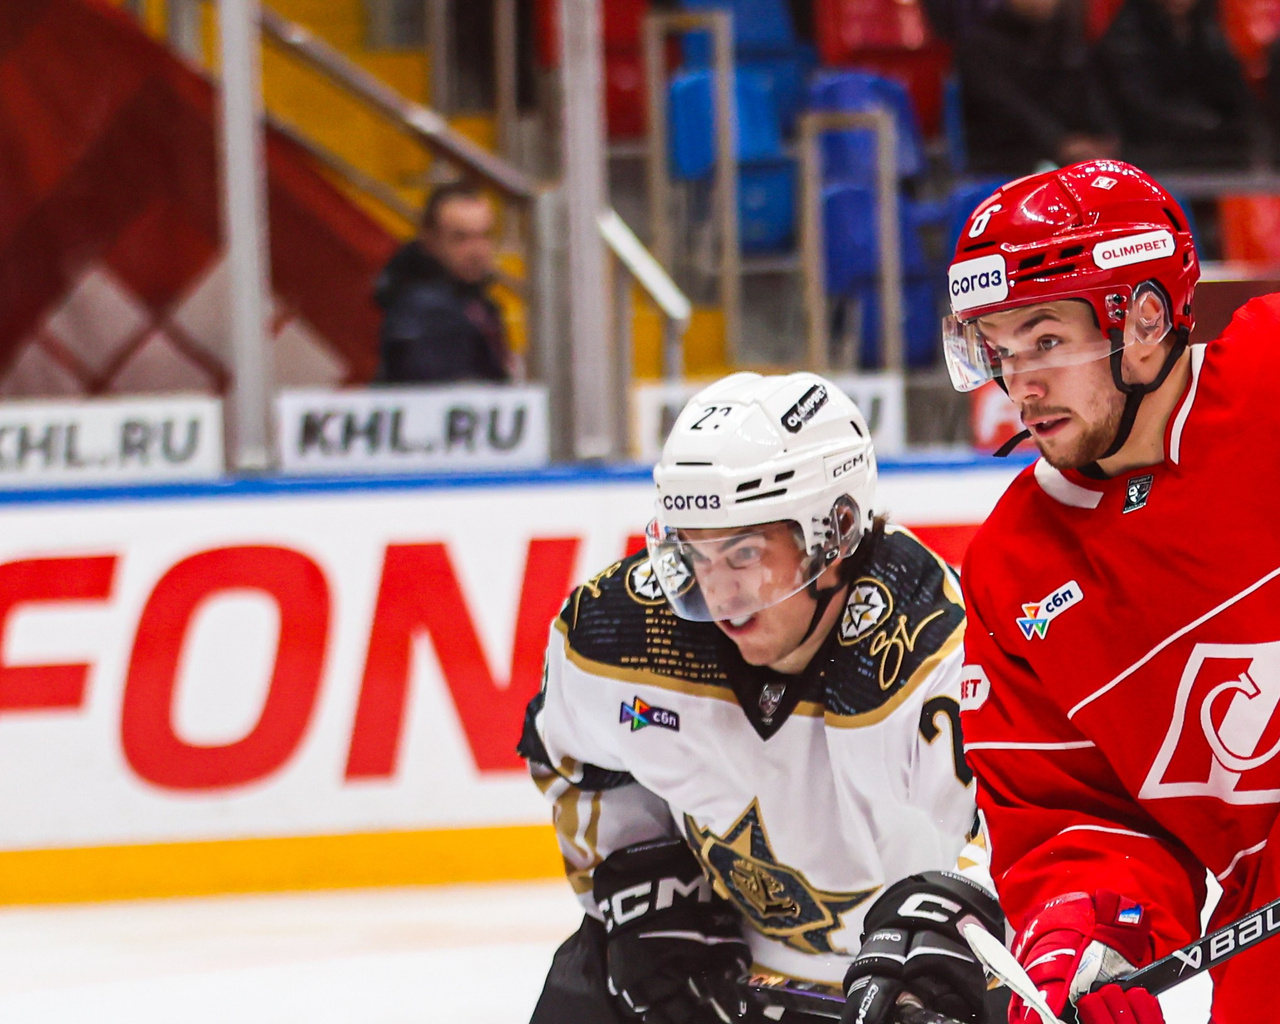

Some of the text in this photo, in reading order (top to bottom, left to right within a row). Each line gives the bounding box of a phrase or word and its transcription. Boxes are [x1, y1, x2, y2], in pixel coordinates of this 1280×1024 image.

[967, 203, 1003, 239] 6
[1101, 238, 1168, 261] OLIMPBET
[951, 269, 1002, 297] согаз
[298, 403, 527, 456] KHL.RU
[832, 453, 865, 478] CCM
[663, 491, 721, 511] согаз
[1045, 588, 1075, 615] сбп
